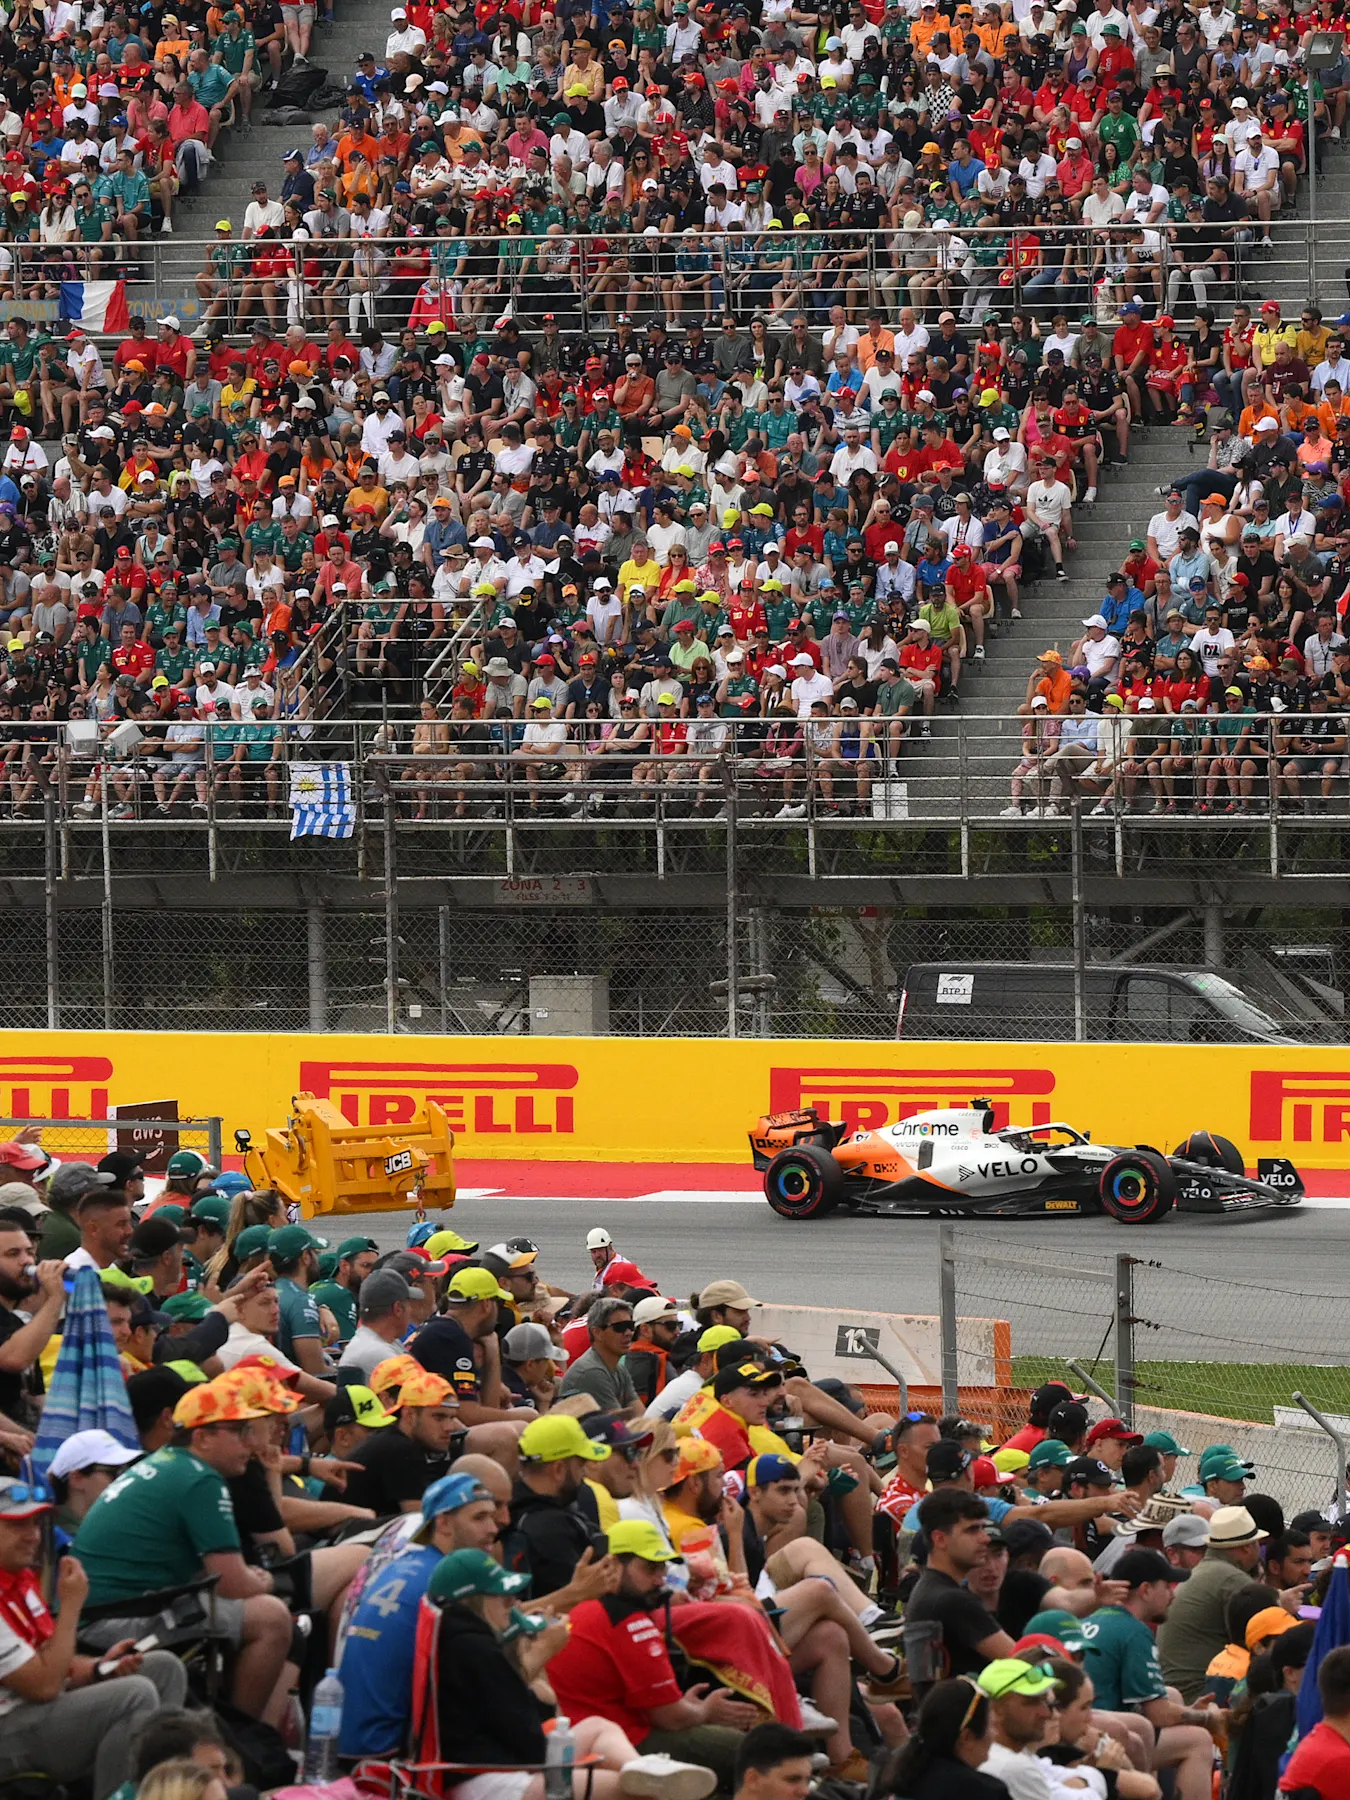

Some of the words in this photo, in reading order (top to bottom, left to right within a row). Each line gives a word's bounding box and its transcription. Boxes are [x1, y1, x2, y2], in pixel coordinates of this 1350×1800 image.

[6, 301, 48, 321] ZONA
[169, 301, 177, 317] 2
[500, 879, 543, 891] ZONA
[892, 1122, 959, 1136] Chrome
[385, 1151, 412, 1175] JCB
[874, 1163, 897, 1172] OKX
[977, 1158, 1038, 1179] VELO
[1260, 1174, 1296, 1186] VELO
[1045, 1200, 1078, 1210] DEWALT
[358, 1399, 374, 1414] 14
[368, 1579, 407, 1618] 4
